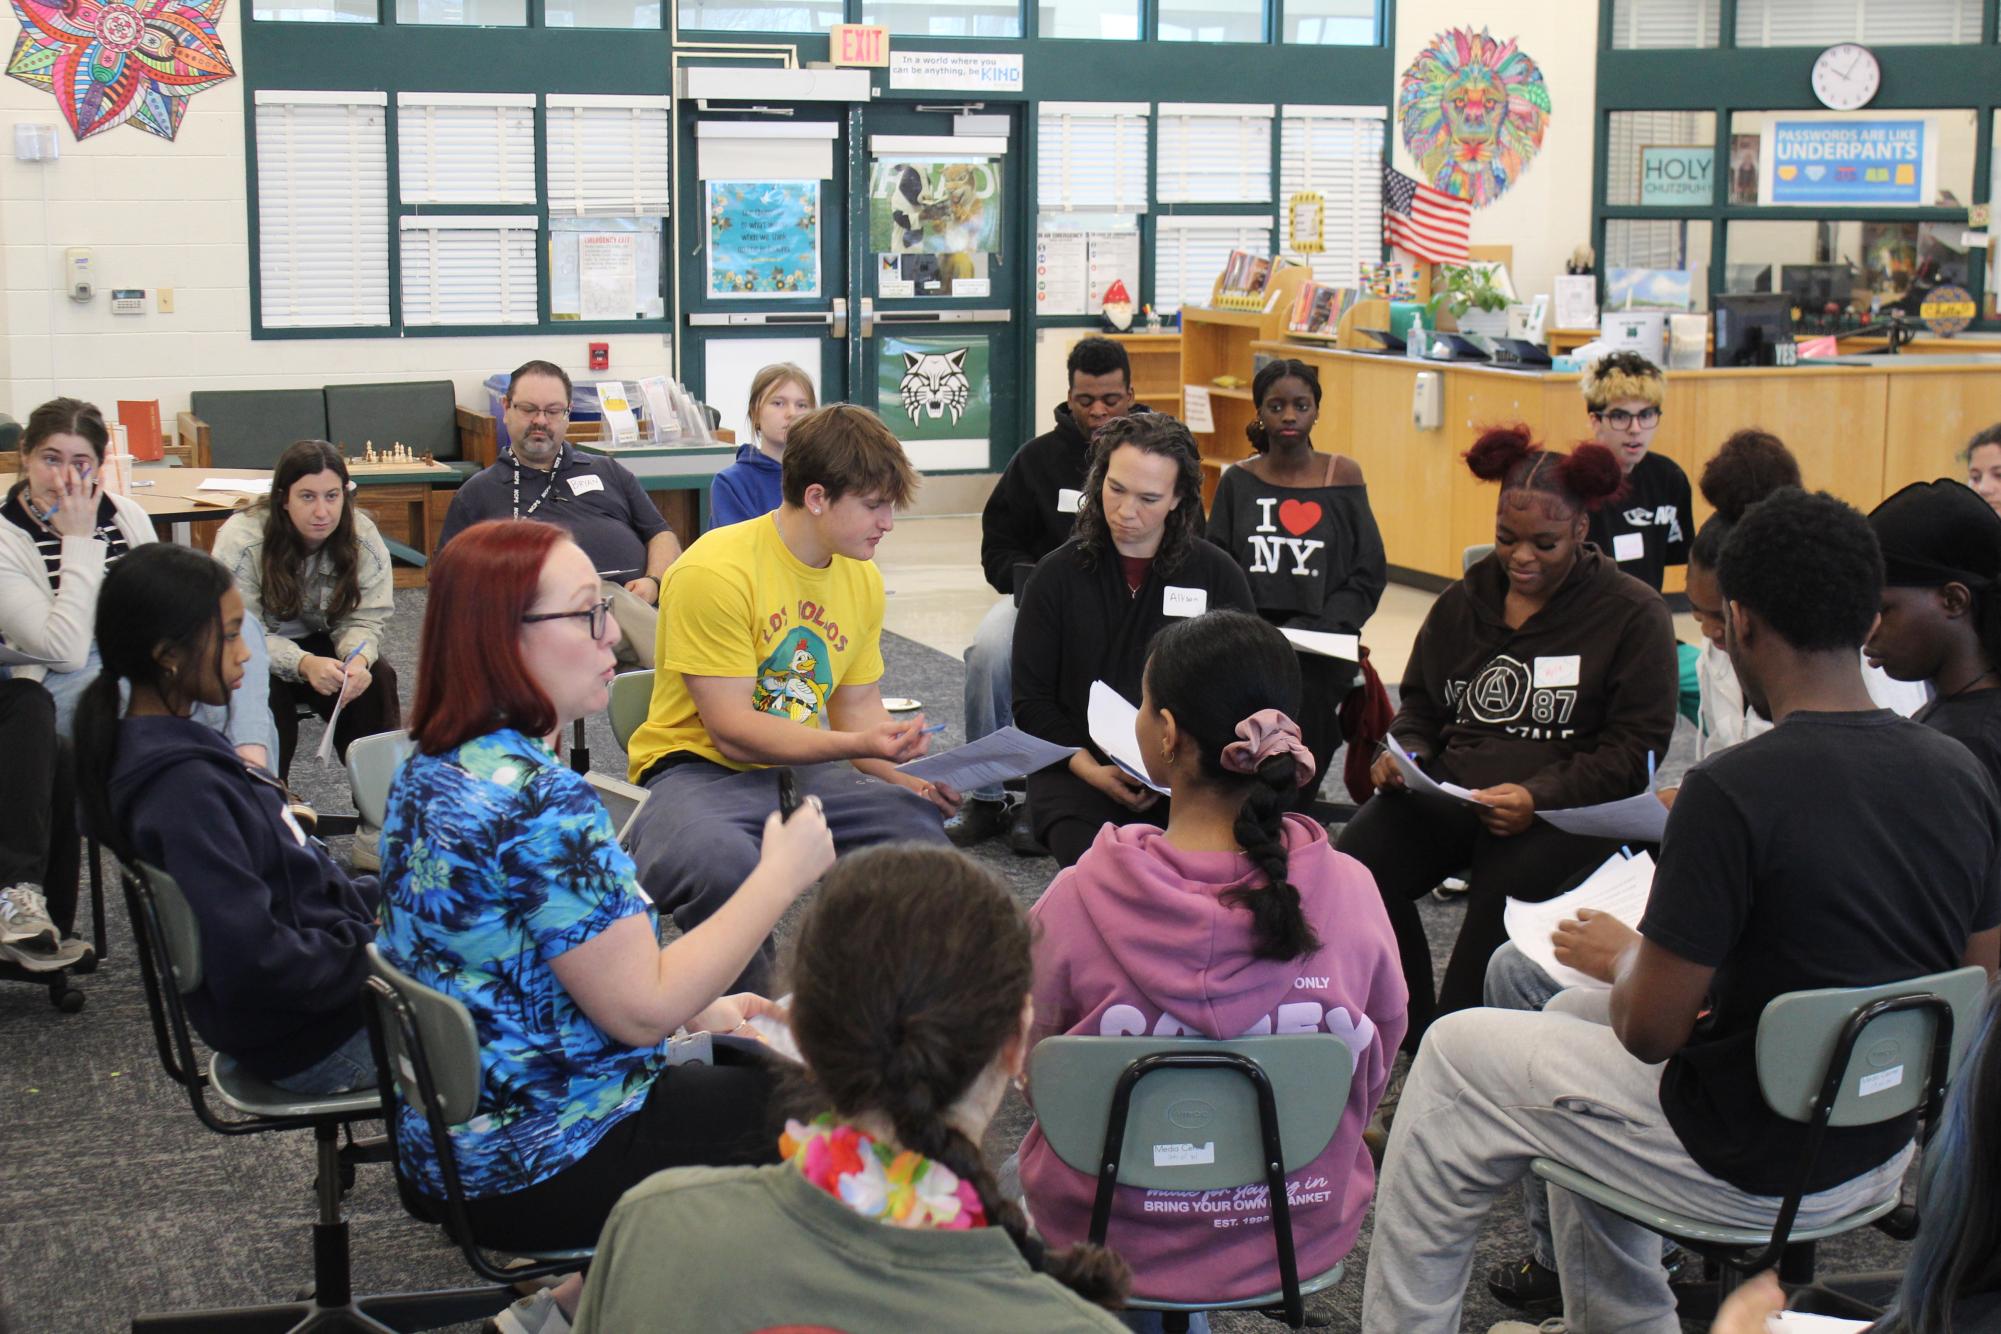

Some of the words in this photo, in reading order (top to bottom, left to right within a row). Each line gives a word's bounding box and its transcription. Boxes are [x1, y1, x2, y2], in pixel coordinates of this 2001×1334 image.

[843, 29, 882, 62] EXIT
[902, 56, 913, 64] In
[922, 56, 948, 64] world
[950, 56, 978, 65] where
[981, 58, 997, 66] you
[911, 65, 921, 74] be
[925, 66, 966, 76] anything,
[968, 66, 980, 75] be
[981, 67, 1020, 81] KIND
[1778, 129, 1857, 141] PASSWORDS
[1860, 129, 1885, 141] ARE
[1888, 129, 1918, 141] LIKE
[1777, 142, 1918, 160] UNDERPANTS
[1646, 157, 1712, 180] HOLY
[1775, 343, 1797, 365] YES
[1256, 498, 1278, 533] I
[1532, 688, 1578, 724] 87
[1294, 977, 1330, 989] ONLY
[1233, 1180, 1300, 1202] stayg
[1305, 1176, 1328, 1188] in
[1144, 1201, 1189, 1213] BRING
[1193, 1200, 1231, 1213] YOUR
[1234, 1198, 1267, 1211] OWN
[1270, 1191, 1331, 1209] ANKET
[1214, 1219, 1239, 1228] EST.
